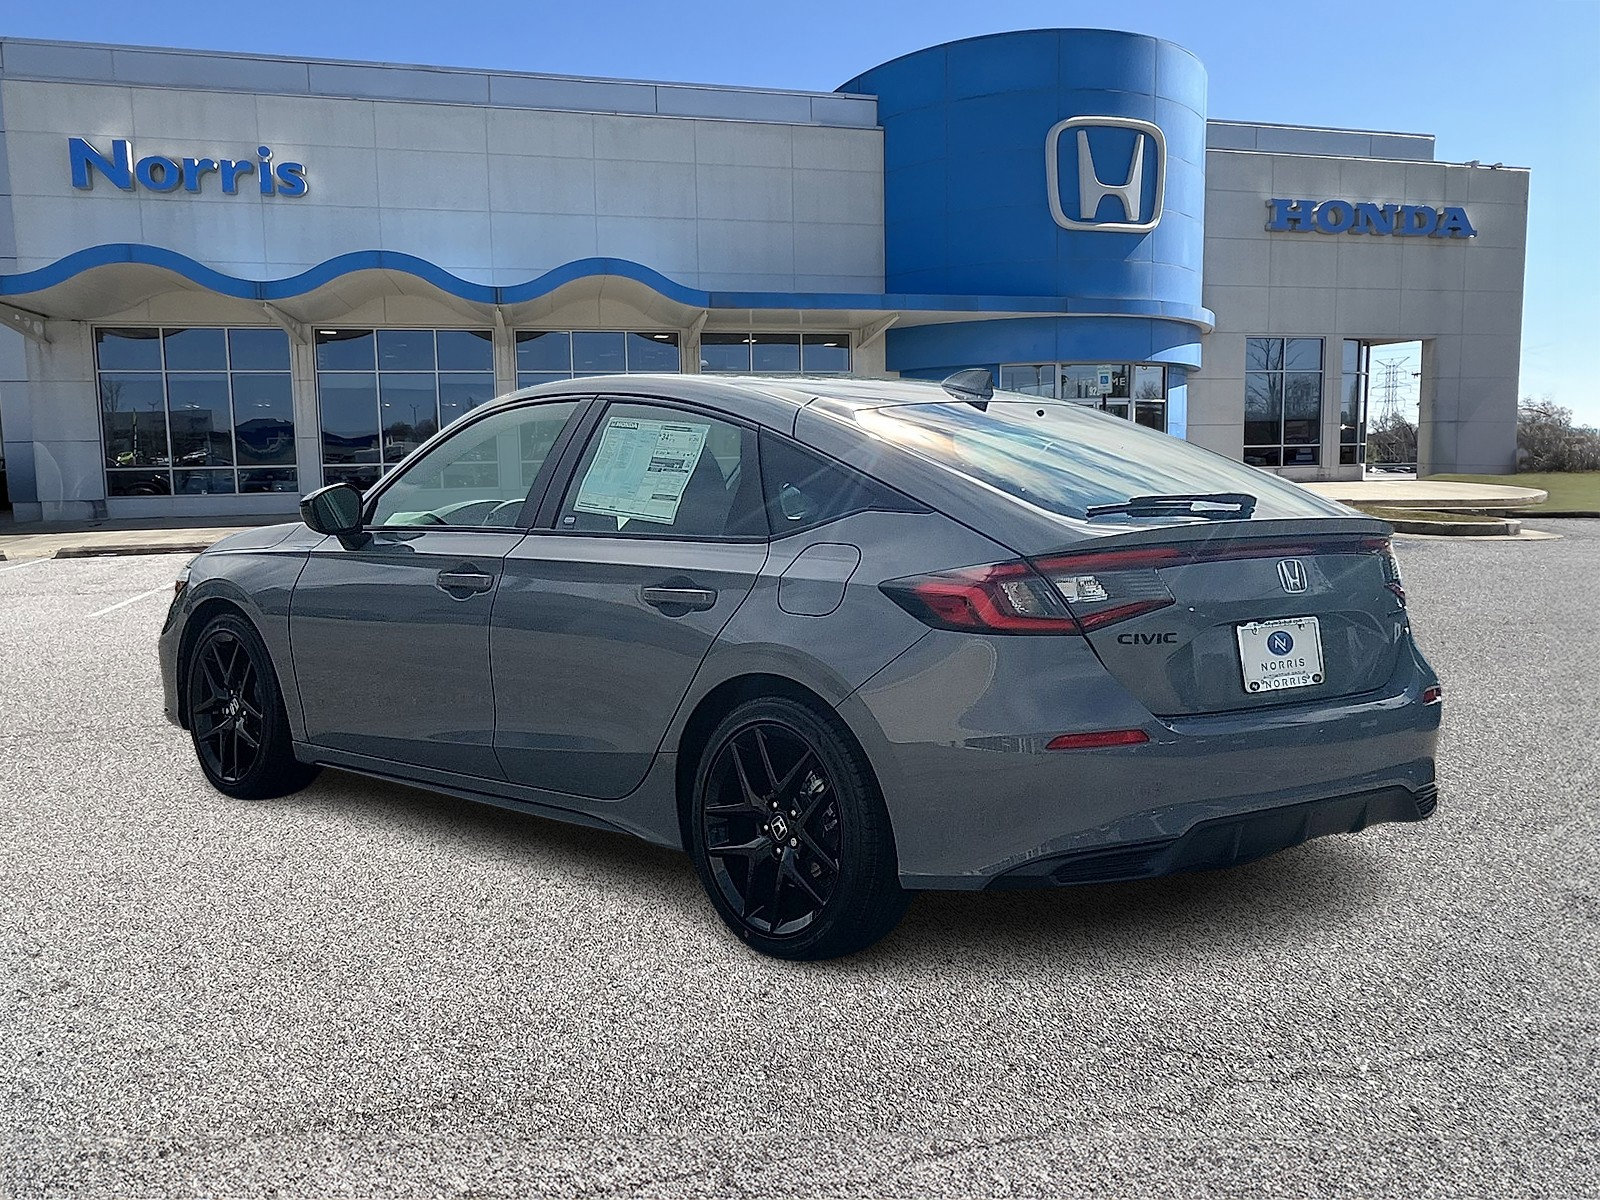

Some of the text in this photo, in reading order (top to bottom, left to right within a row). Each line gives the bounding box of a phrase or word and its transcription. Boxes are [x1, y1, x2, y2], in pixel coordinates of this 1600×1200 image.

[68, 137, 309, 198] Norris
[1265, 198, 1478, 240] HONDA
[1117, 632, 1178, 646] CIVIC
[1261, 658, 1305, 672] NORRIS
[1265, 676, 1308, 689] NORRIS
